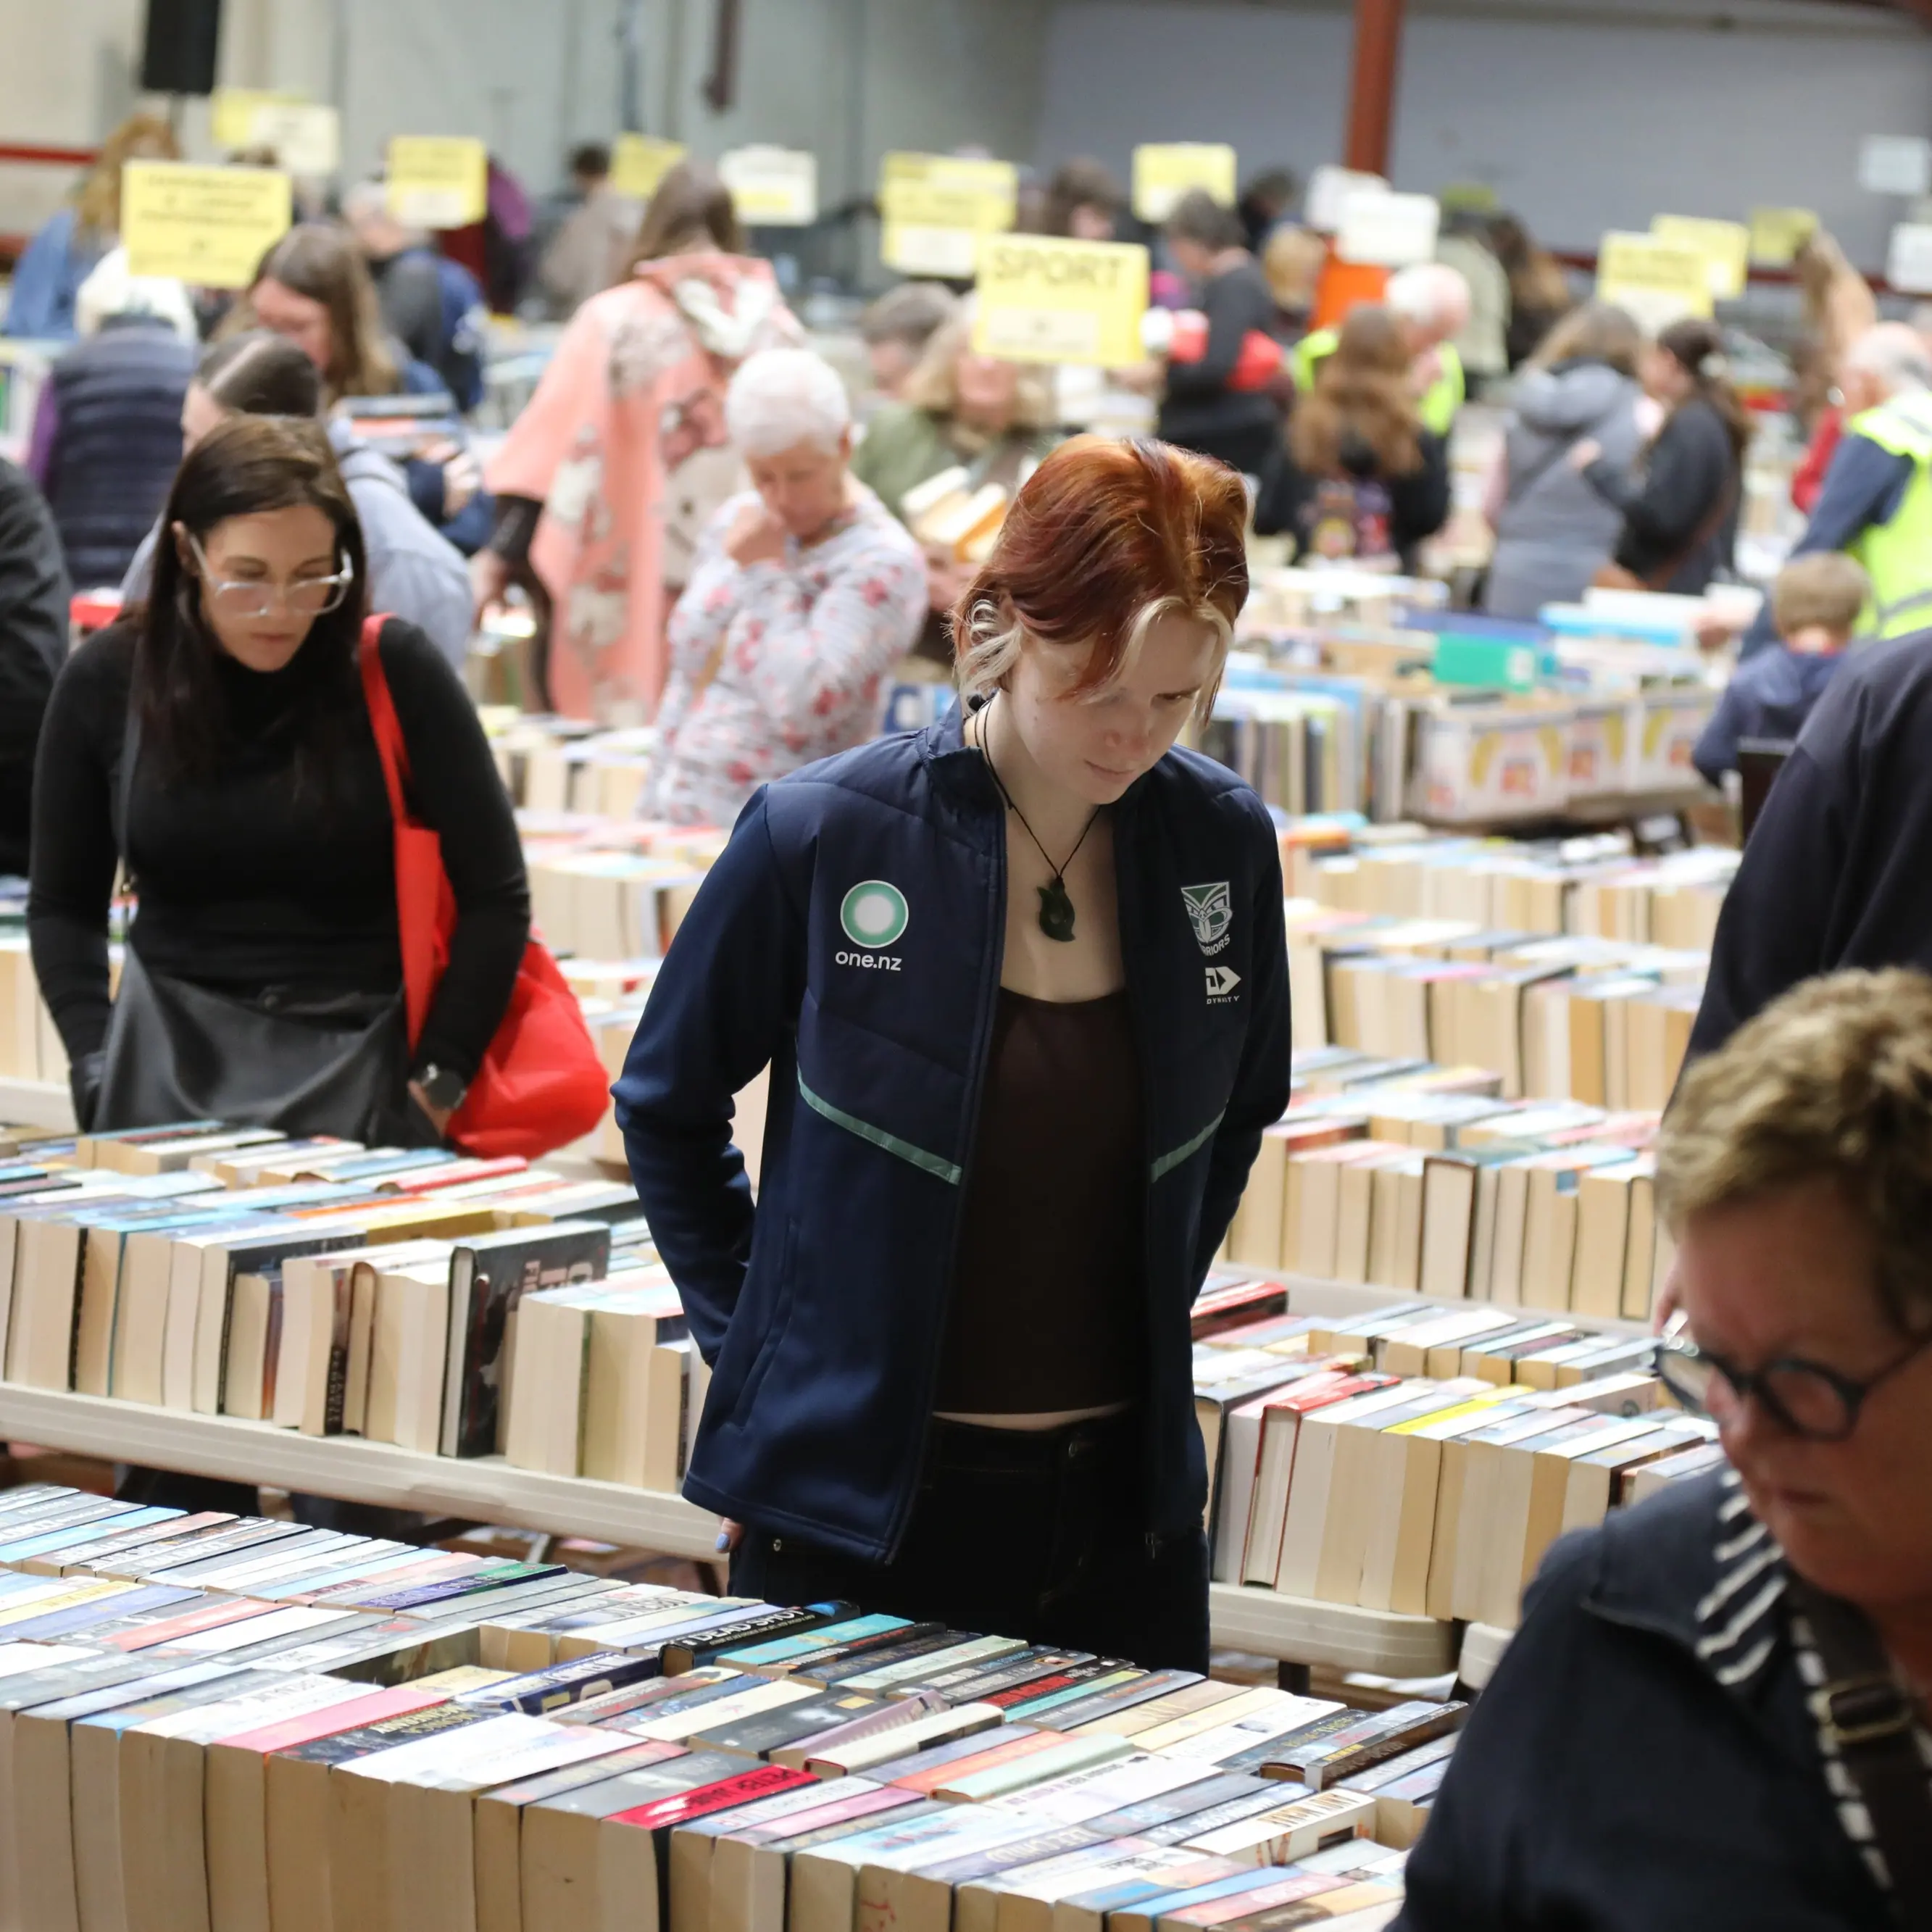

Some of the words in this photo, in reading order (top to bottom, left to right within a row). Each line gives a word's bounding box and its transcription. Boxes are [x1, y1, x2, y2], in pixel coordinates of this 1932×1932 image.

[994, 245, 1125, 289] SPORT
[1199, 933, 1231, 957] RRIORS
[836, 951, 902, 971] one.nz
[696, 1619, 751, 1641] DEAD
[750, 1608, 805, 1626] SHOT
